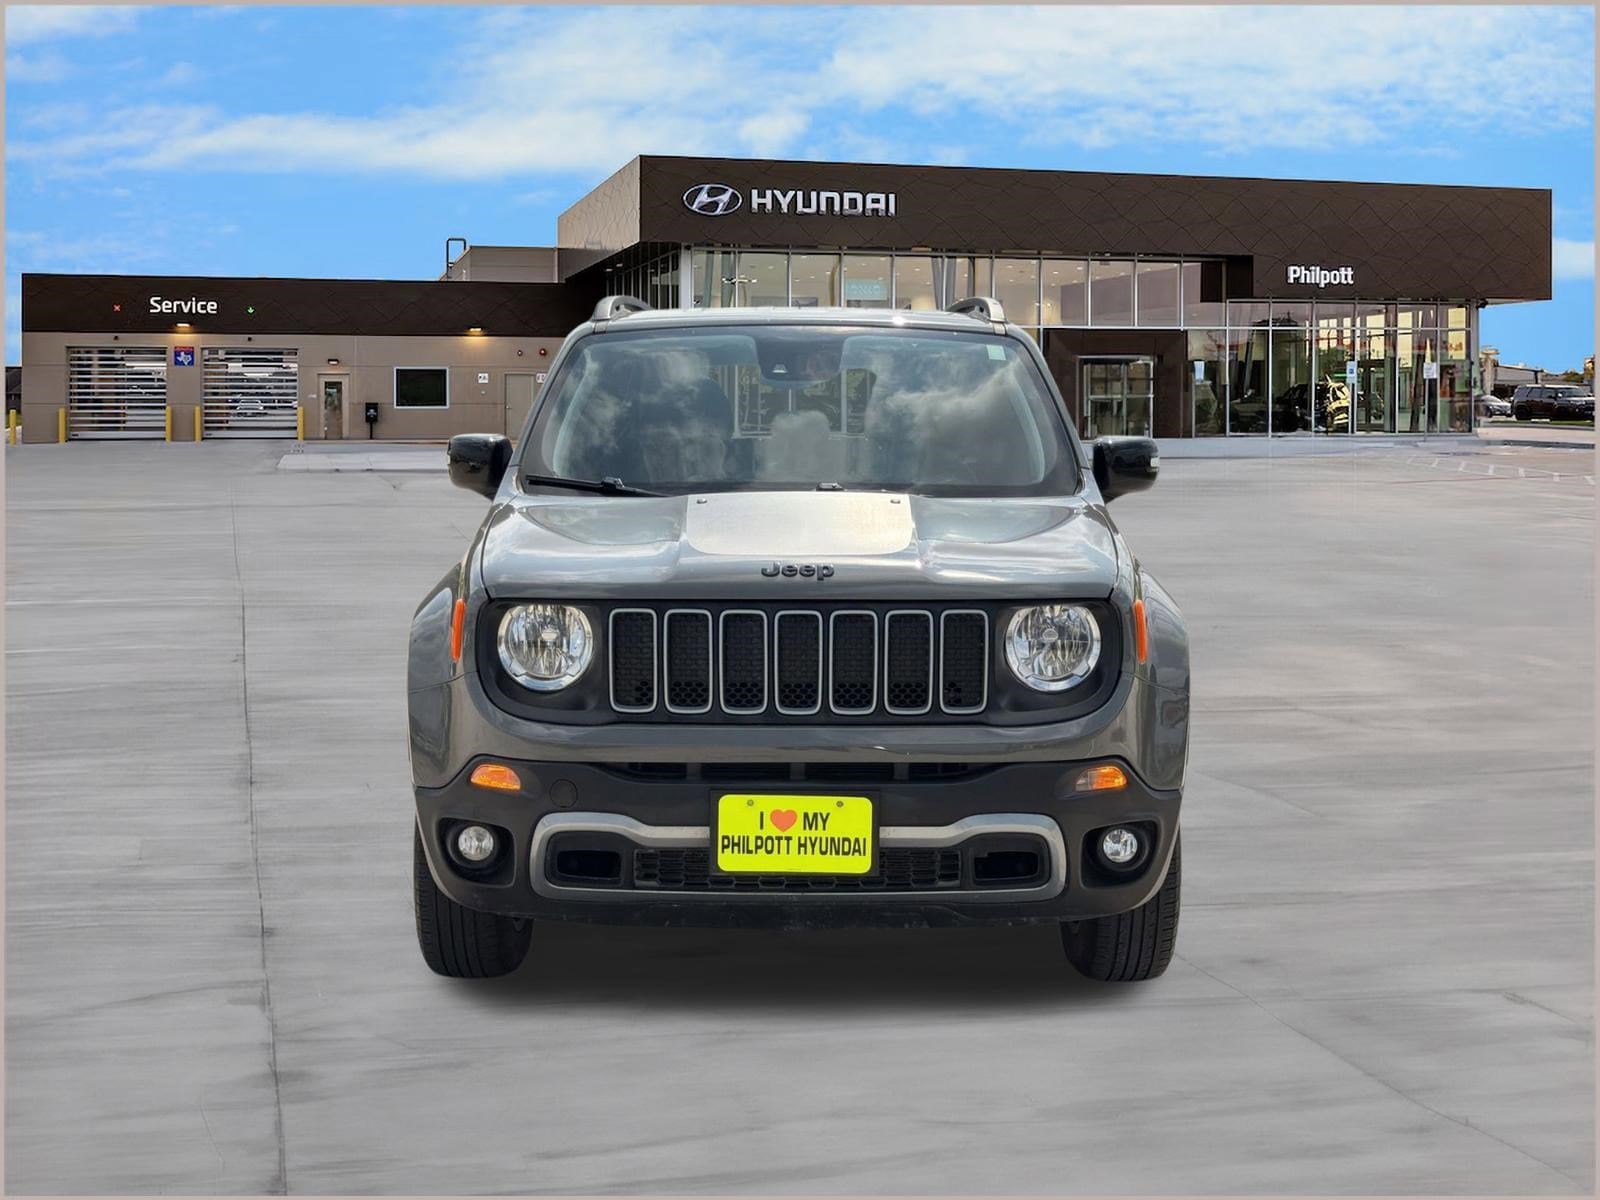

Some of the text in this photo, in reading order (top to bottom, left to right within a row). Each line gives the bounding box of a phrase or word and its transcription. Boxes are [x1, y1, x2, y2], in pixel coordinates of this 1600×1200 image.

[751, 188, 896, 216] HYUNDAI
[1286, 265, 1355, 288] Philpott
[149, 296, 218, 314] Service
[761, 562, 834, 581] Jeep
[759, 811, 830, 831] I MY
[721, 834, 867, 857] PHILPOTT HYUNDAI
